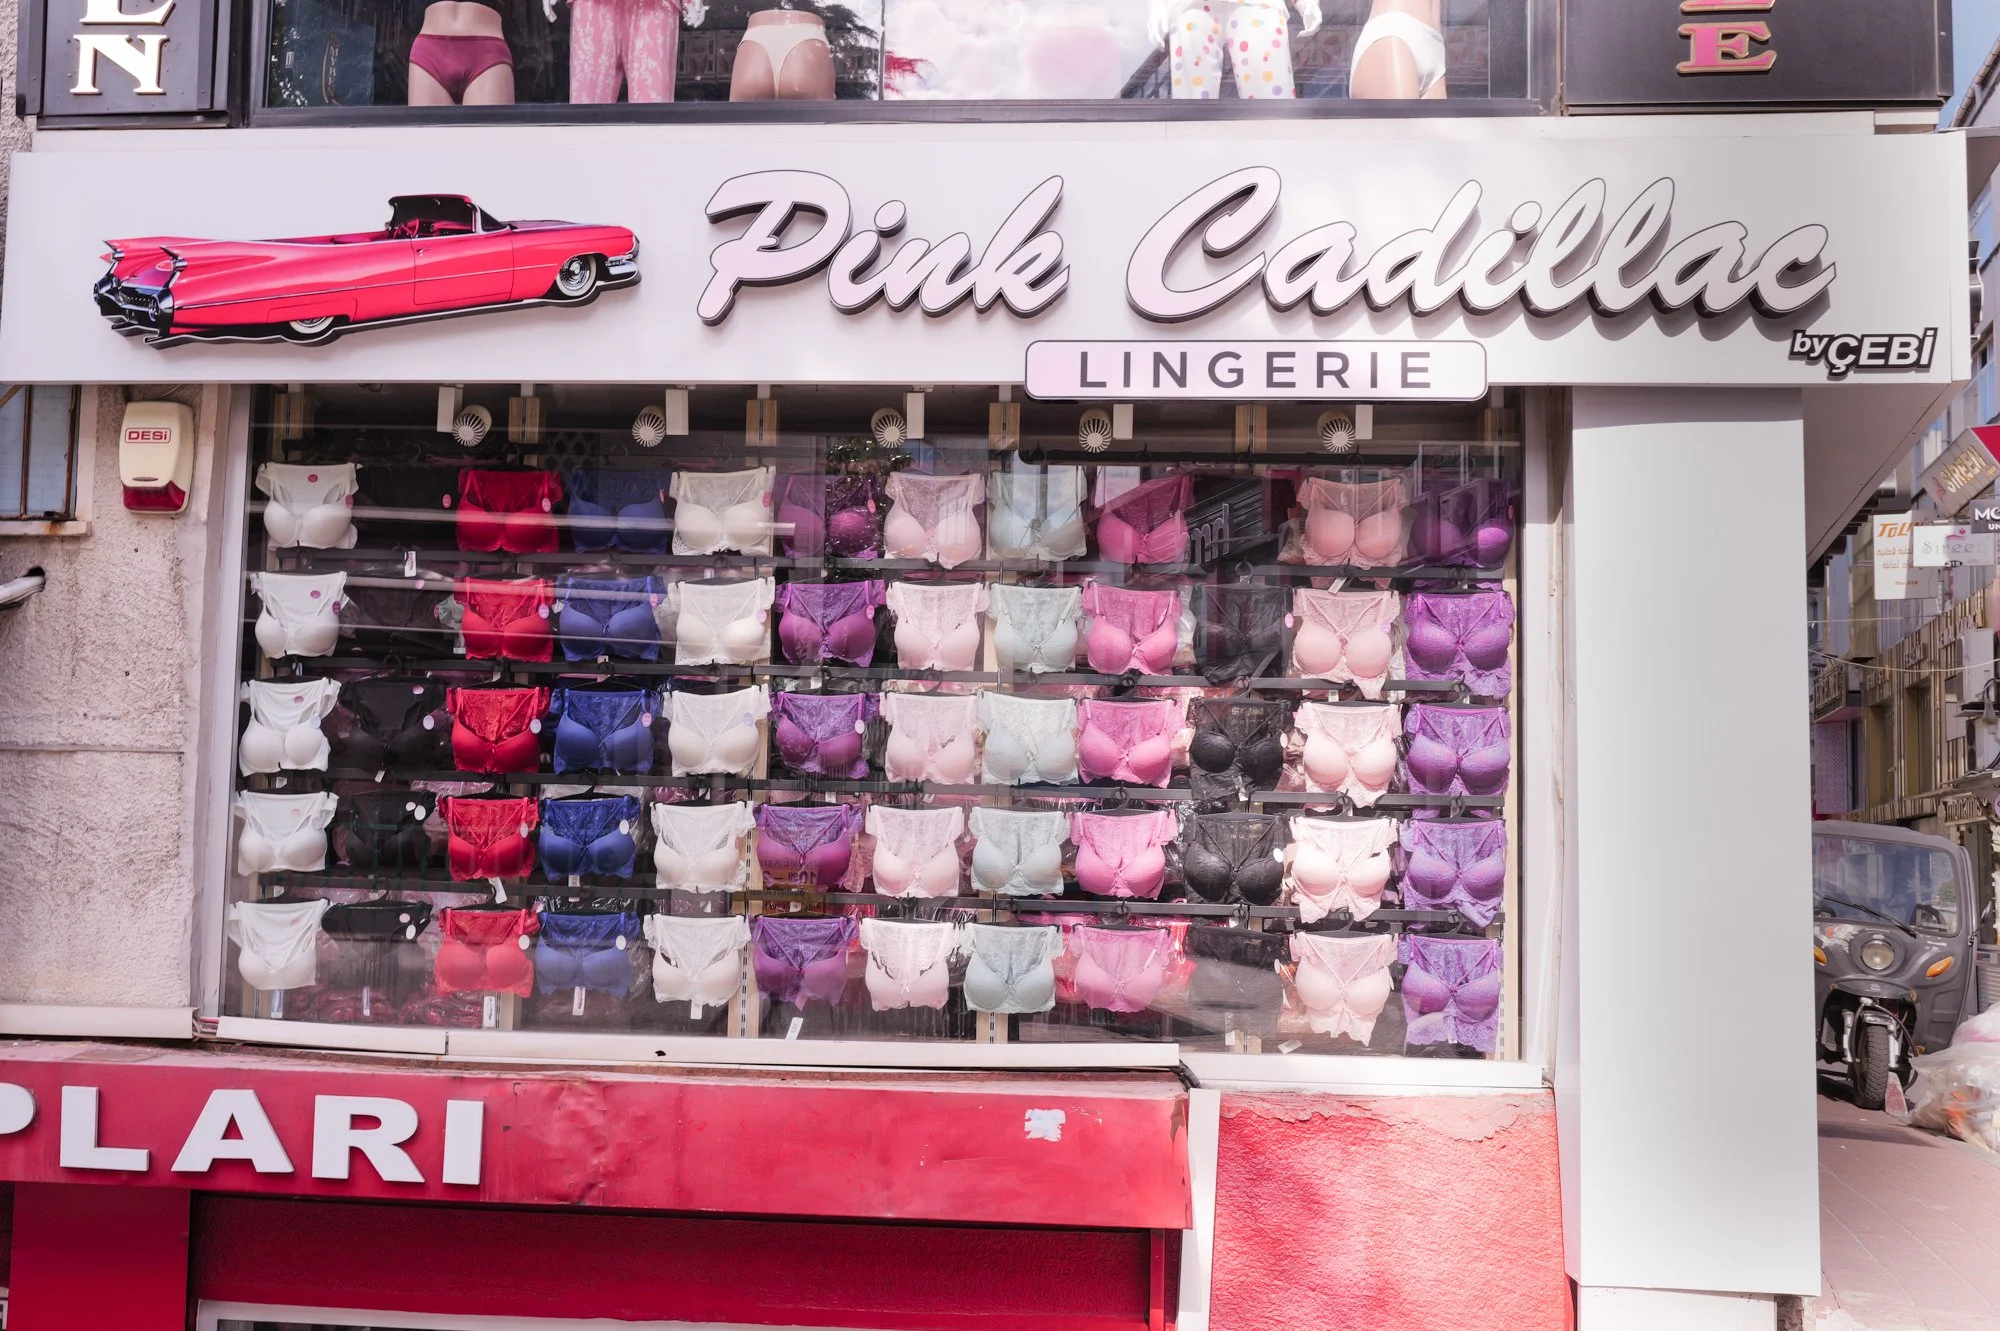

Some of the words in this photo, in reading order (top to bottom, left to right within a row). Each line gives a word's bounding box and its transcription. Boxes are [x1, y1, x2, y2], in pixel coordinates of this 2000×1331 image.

[697, 170, 1071, 325] Pink
[1126, 166, 1837, 325] Cadillac
[1080, 350, 1432, 389] LINGERIE
[1792, 331, 1829, 358] by
[1827, 327, 1936, 375] ÇEBİ
